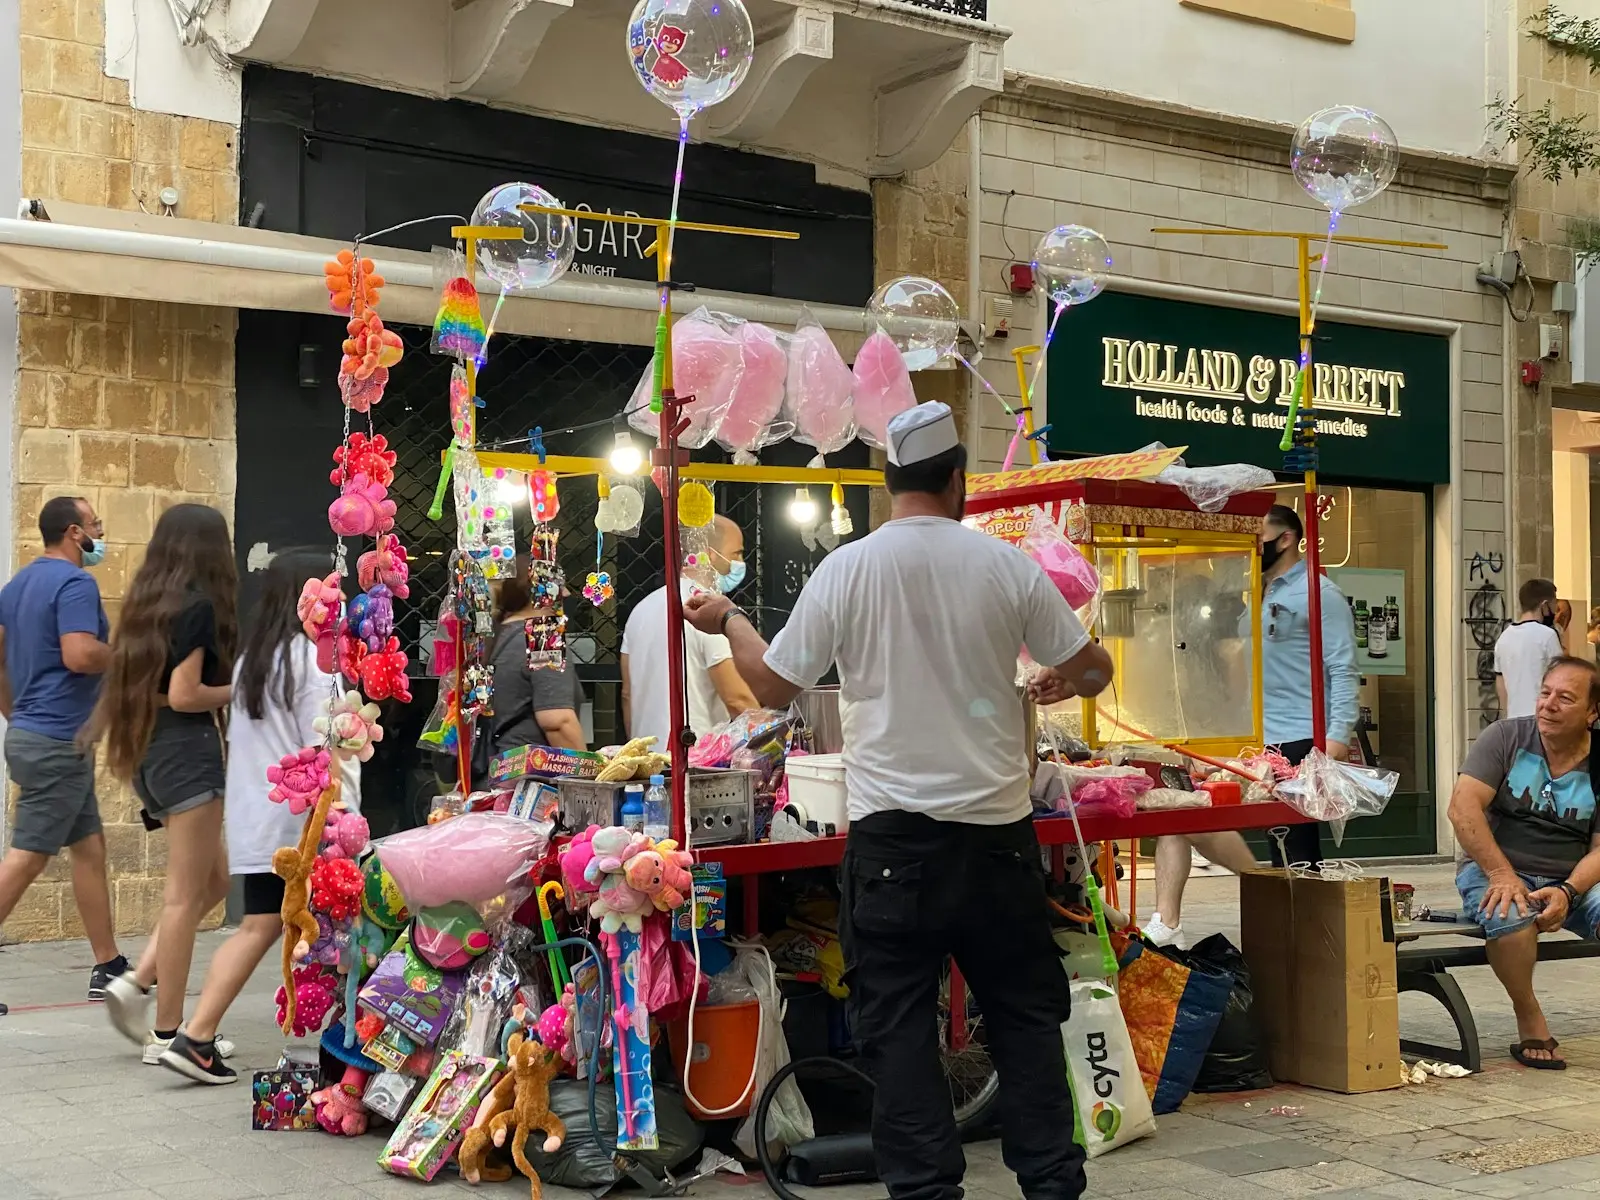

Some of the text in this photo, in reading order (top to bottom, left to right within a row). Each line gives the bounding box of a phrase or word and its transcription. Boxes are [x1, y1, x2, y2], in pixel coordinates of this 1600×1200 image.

[520, 195, 644, 260] SUGAR
[571, 262, 617, 278] & NIGHT
[1102, 337, 1406, 417] HOLLAND & BRRETT
[1136, 395, 1182, 420] health
[1186, 400, 1228, 424] foods
[1232, 405, 1246, 426] &
[1312, 416, 1368, 438] emedies
[541, 763, 576, 775] MASSAGE
[1085, 1032, 1120, 1098] cyta
